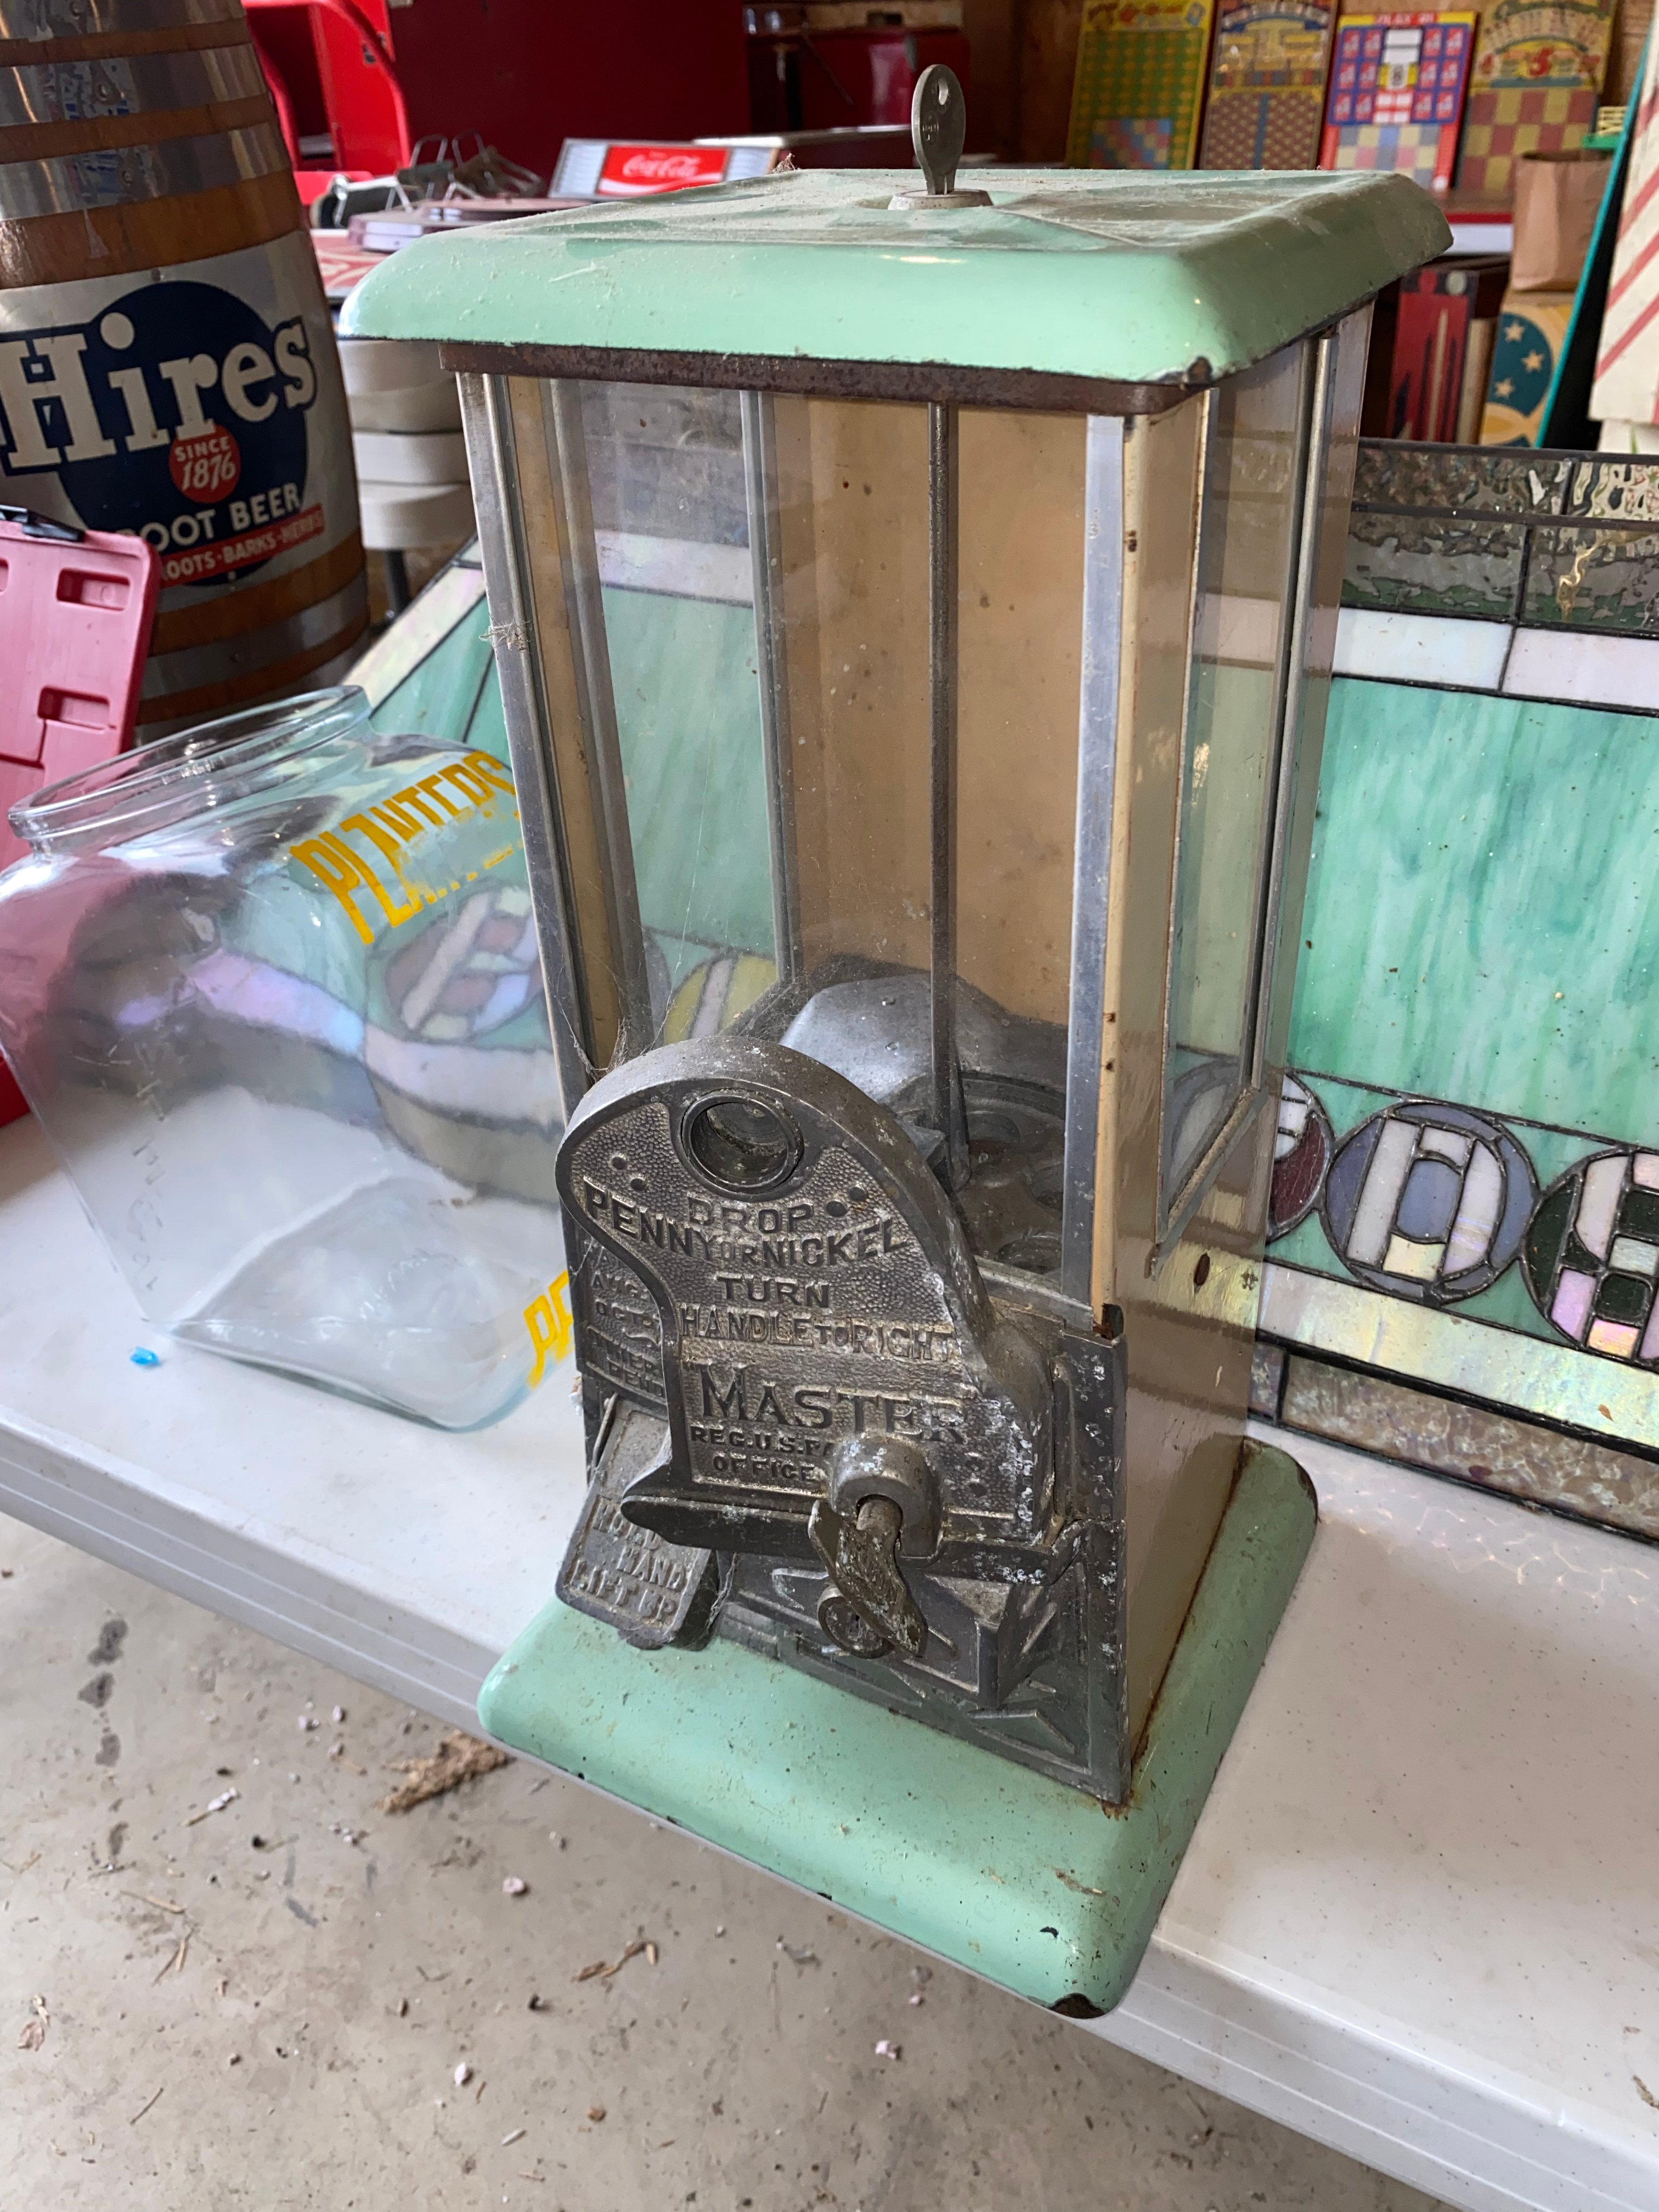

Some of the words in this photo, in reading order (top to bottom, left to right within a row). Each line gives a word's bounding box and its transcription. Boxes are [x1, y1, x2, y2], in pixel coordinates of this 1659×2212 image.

[0, 312, 314, 468] Hires
[174, 436, 231, 462] SINCE
[182, 452, 236, 492] 1876
[117, 508, 216, 552] OOT
[229, 482, 300, 532] BEER
[164, 551, 216, 580] OOTS
[583, 1175, 713, 1261] PENNY
[719, 1240, 757, 1263] OR
[761, 1217, 910, 1267] NICKEL
[687, 1197, 814, 1233] DROP
[715, 1271, 831, 1308] TURN
[677, 1302, 814, 1347] HANDLE
[814, 1321, 849, 1347] TO
[851, 1318, 955, 1362] RIGHT
[689, 1362, 969, 1445] MASTER
[714, 1452, 816, 1481] OFFICE
[617, 1546, 685, 1589] HAND
